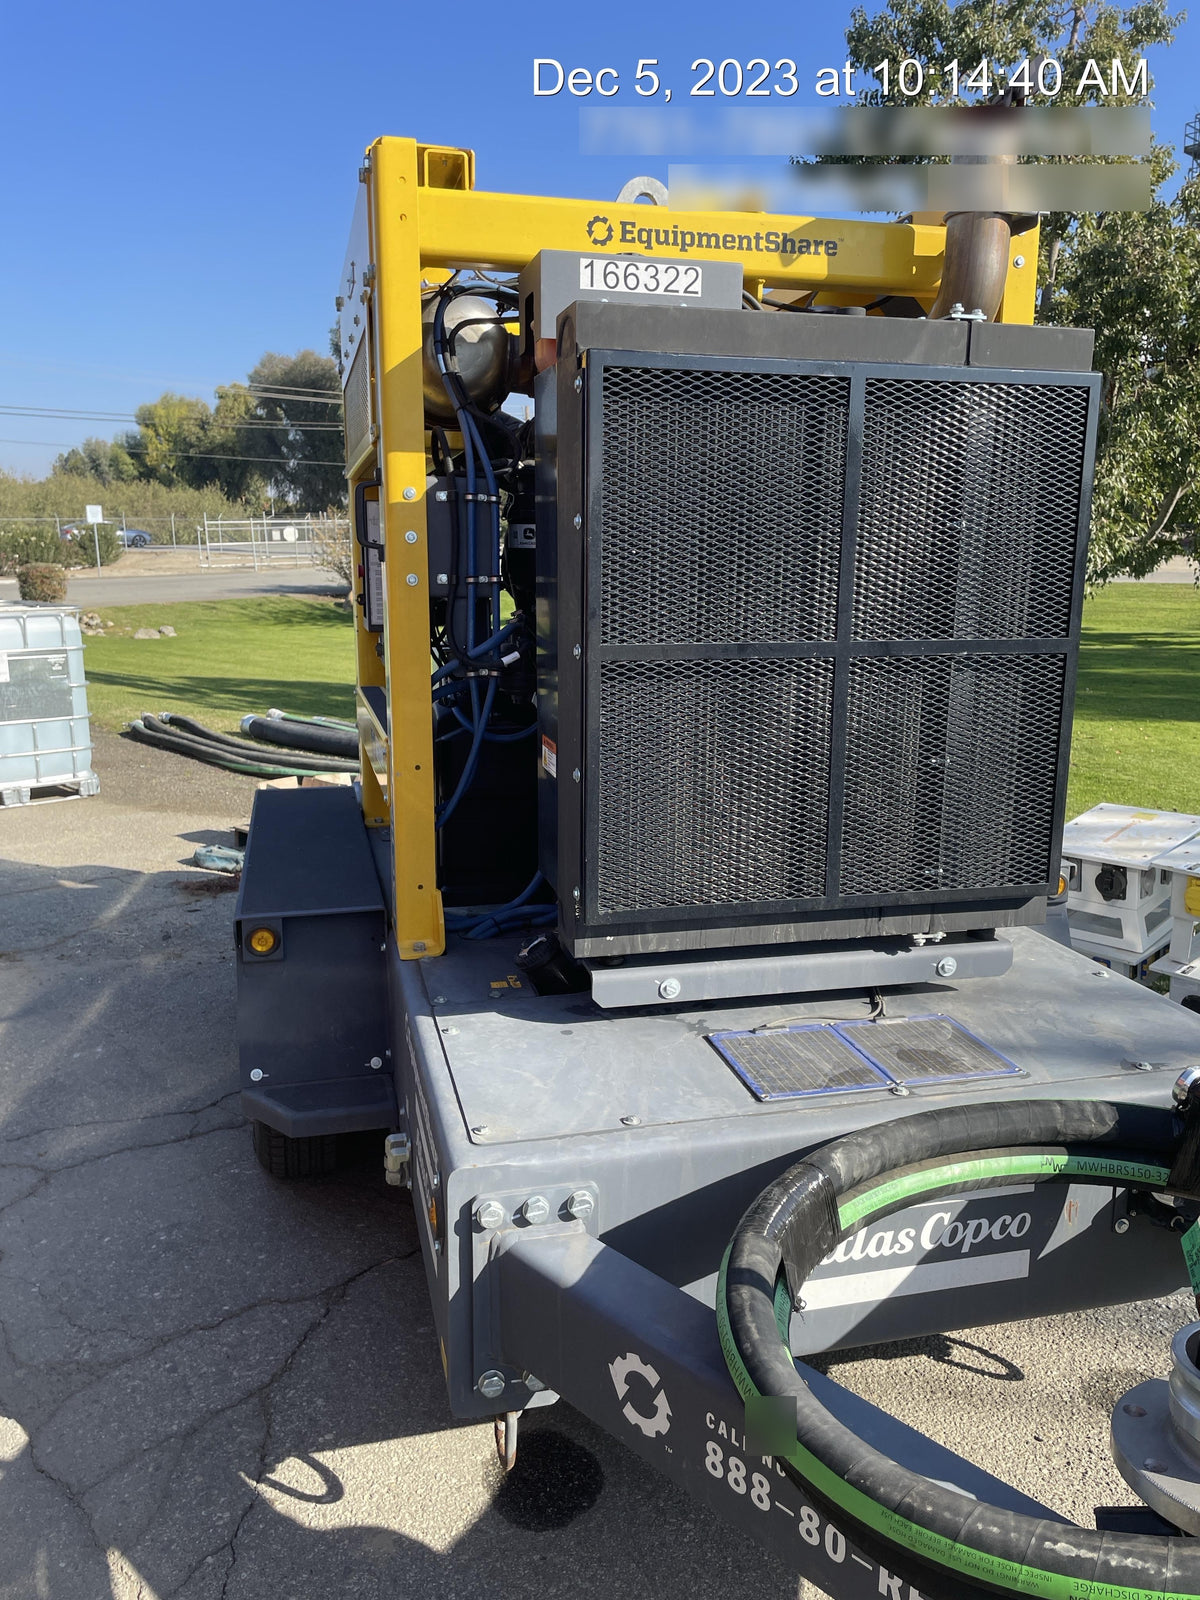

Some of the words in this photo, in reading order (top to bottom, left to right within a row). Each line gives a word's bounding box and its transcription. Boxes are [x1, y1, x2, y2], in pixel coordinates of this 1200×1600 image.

[619, 220, 839, 257] EquipmentShare
[583, 259, 700, 295] 166322
[1076, 1160, 1169, 1182] MWHBRS150-32
[820, 1227, 914, 1266] tlas
[920, 1211, 1032, 1254] Copco
[996, 1560, 1018, 1573] HOSE
[1020, 1567, 1052, 1583] INSPECT
[1073, 1582, 1140, 1600] DISCHARGE
